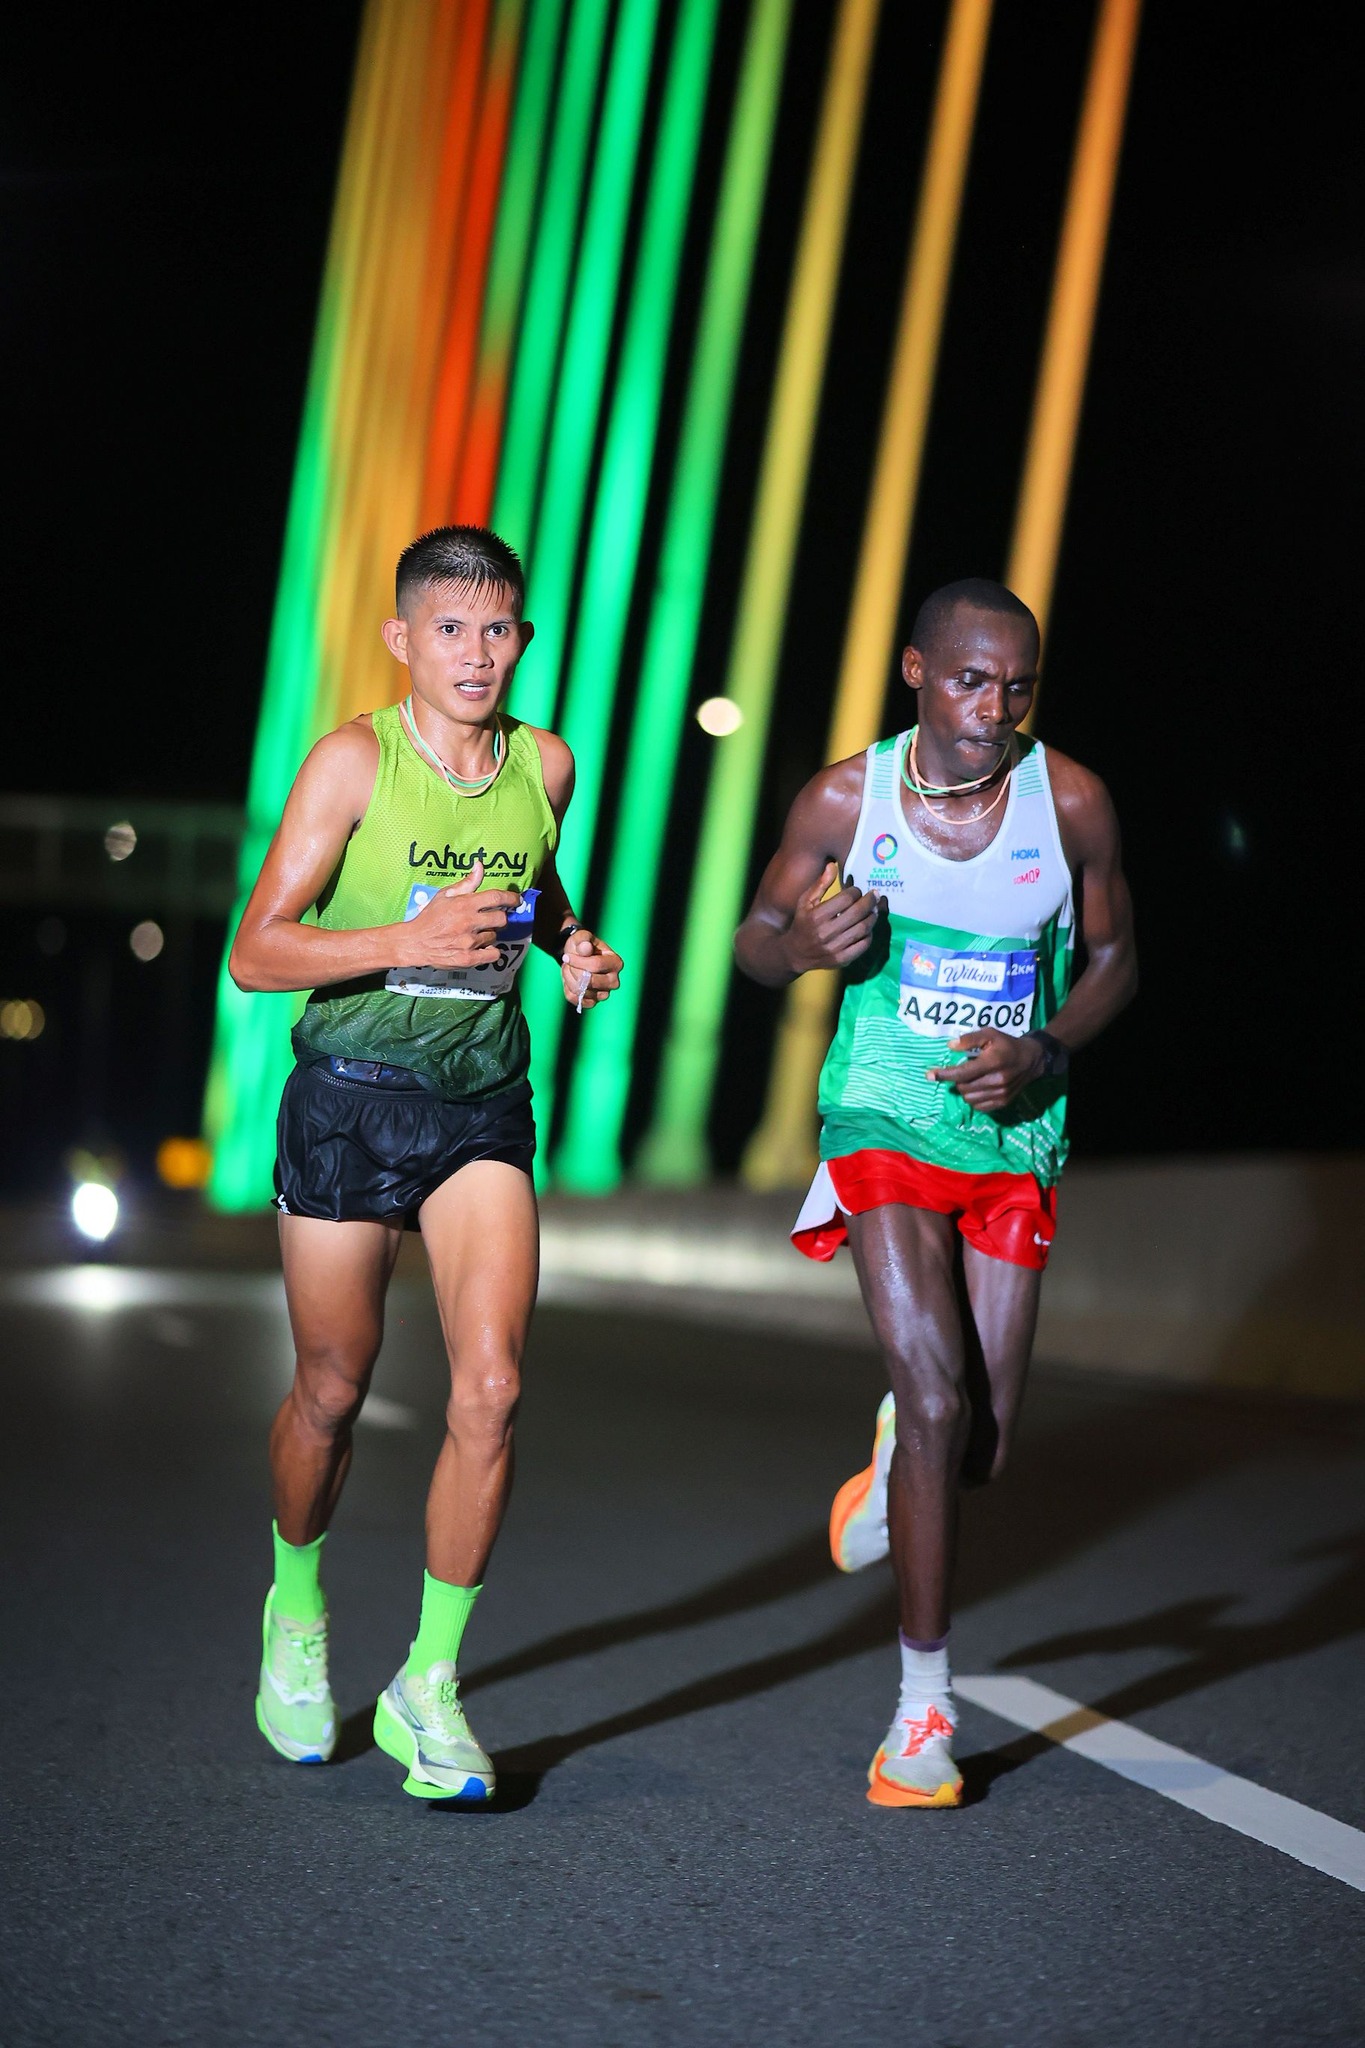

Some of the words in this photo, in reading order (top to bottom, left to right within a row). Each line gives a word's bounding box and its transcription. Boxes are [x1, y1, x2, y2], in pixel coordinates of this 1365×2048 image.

[1011, 848, 1040, 860] HOKA
[943, 963, 998, 983] Wilkins
[459, 987, 486, 996] 42KM
[904, 996, 1026, 1028] A422608
